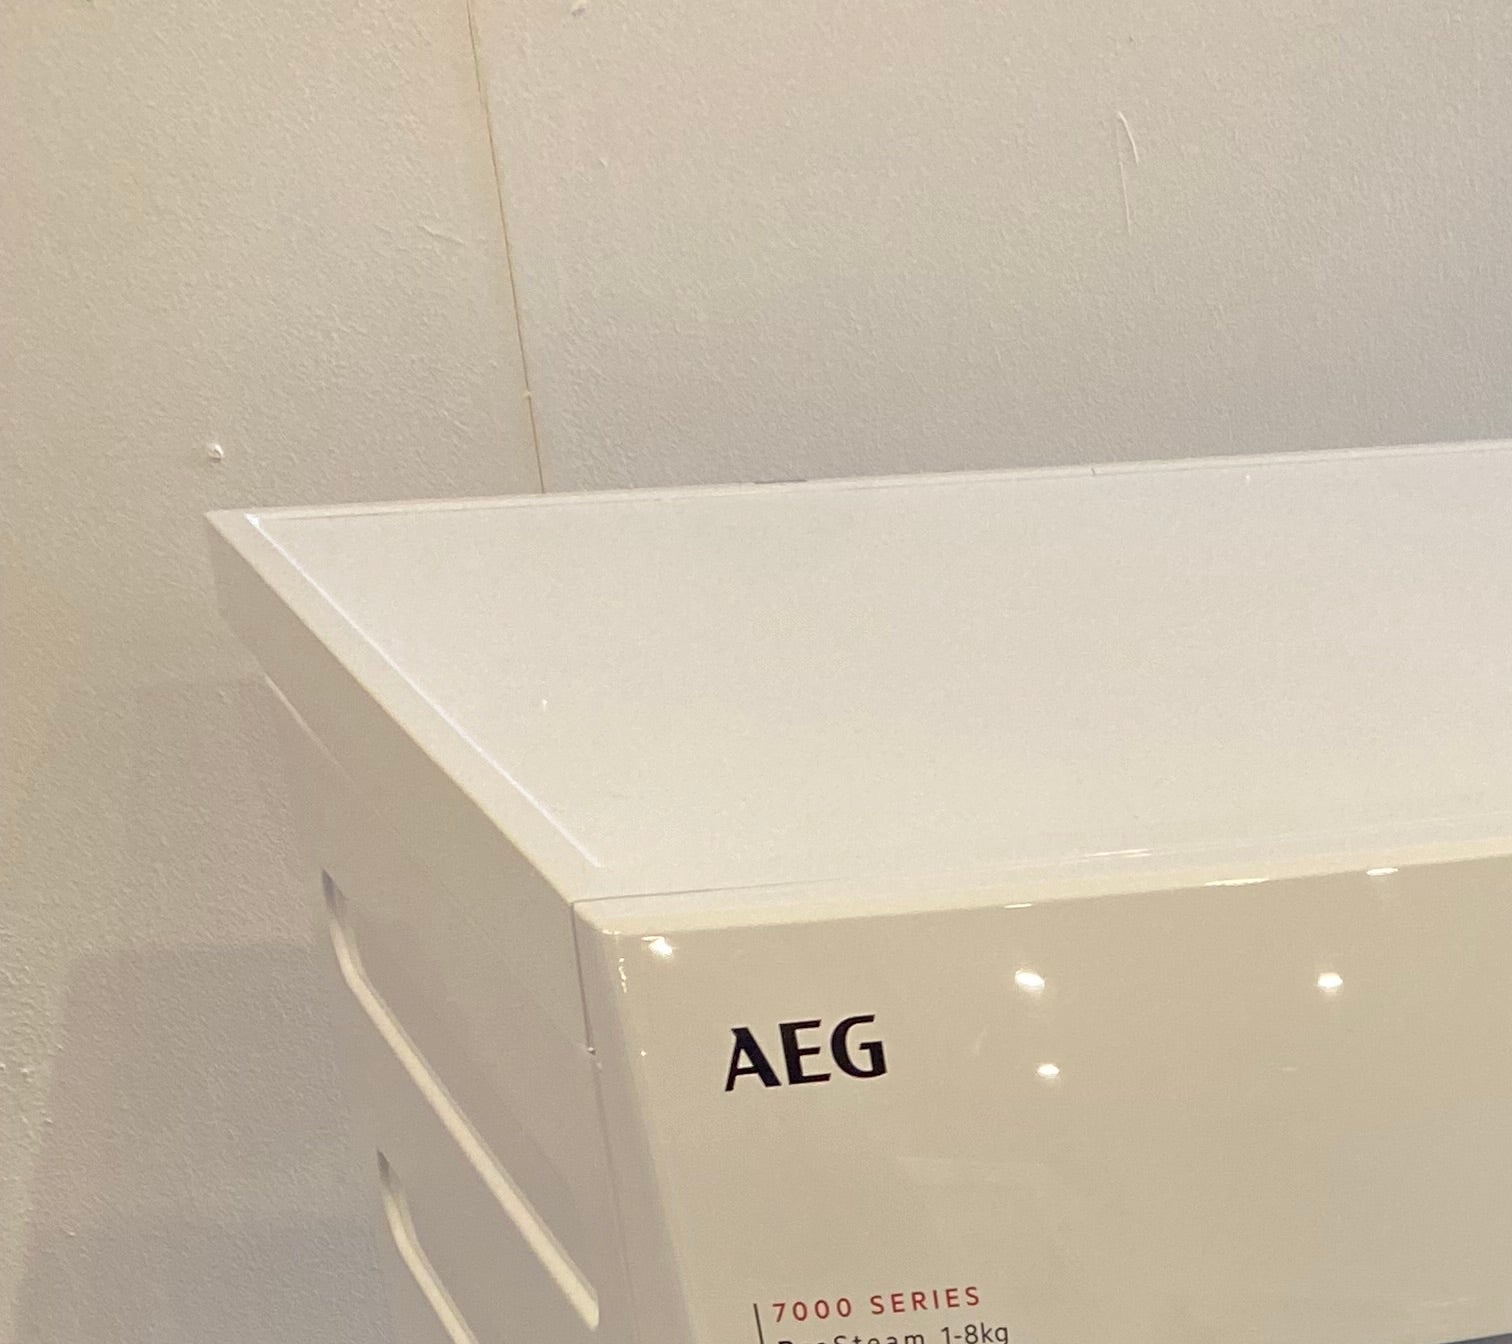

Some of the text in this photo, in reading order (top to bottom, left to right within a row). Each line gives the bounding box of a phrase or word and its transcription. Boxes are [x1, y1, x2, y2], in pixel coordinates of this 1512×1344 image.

[725, 1015, 888, 1092] AEG
[772, 1286, 980, 1323] 7000 SERIES
